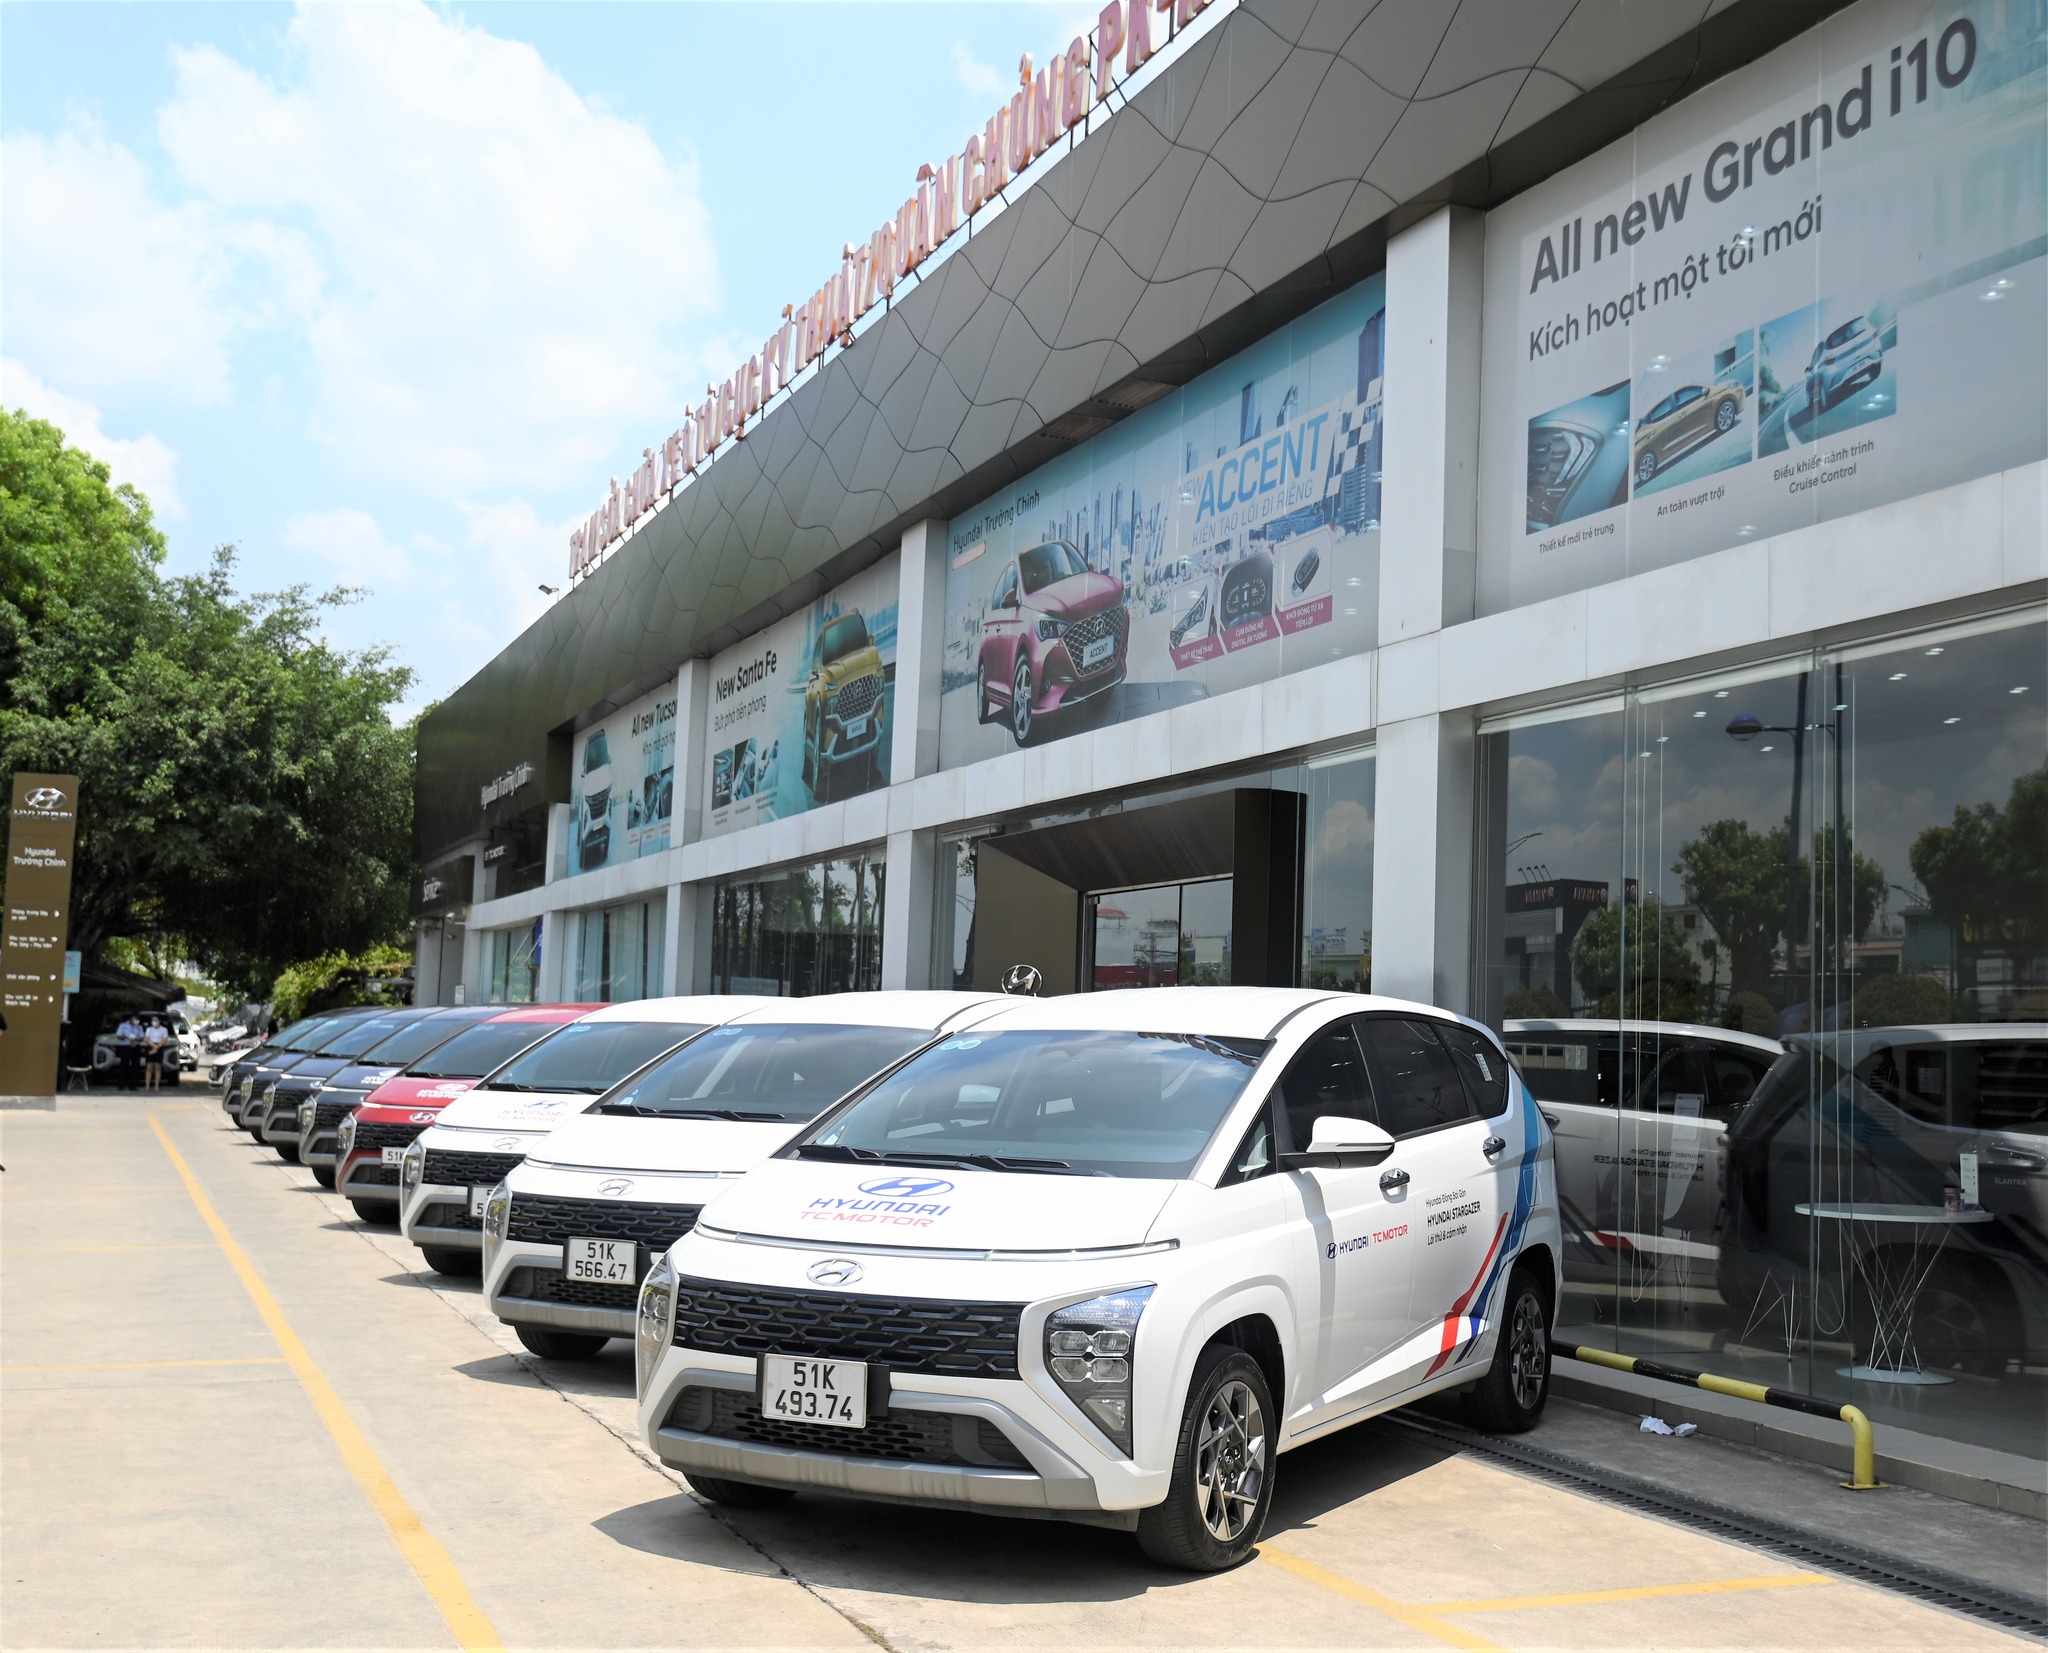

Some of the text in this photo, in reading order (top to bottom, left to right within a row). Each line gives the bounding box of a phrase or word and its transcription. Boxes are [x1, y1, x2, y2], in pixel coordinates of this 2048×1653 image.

[1529, 18, 1977, 295] All new Grand i10
[1529, 194, 1822, 362] Kích hoạt một tôi mới
[1195, 411, 1329, 524] ACCENT
[1789, 462, 1857, 494] Cruise Control
[953, 521, 983, 554] Hyundai
[1016, 489, 1040, 517] Chinh
[1656, 505, 1668, 518] An
[1594, 523, 1615, 538] trung
[715, 650, 777, 704] New Santa Fe
[631, 713, 640, 738] All
[641, 711, 656, 733] new
[1994, 1177, 2028, 1186] ELANTRA
[808, 1198, 951, 1216] HYUNDAI
[1425, 1195, 1442, 1210] Hyundai
[1427, 1200, 1482, 1228] HYUNDAI STARGAZER
[832, 1212, 934, 1228] MOTOR
[587, 1241, 616, 1261] 51K
[1339, 1235, 1369, 1254] HYUNDAI
[1382, 1224, 1408, 1241] MOTOR
[575, 1260, 627, 1281] 566.47
[793, 1361, 836, 1390] 51K
[775, 1389, 853, 1421] 493.74
